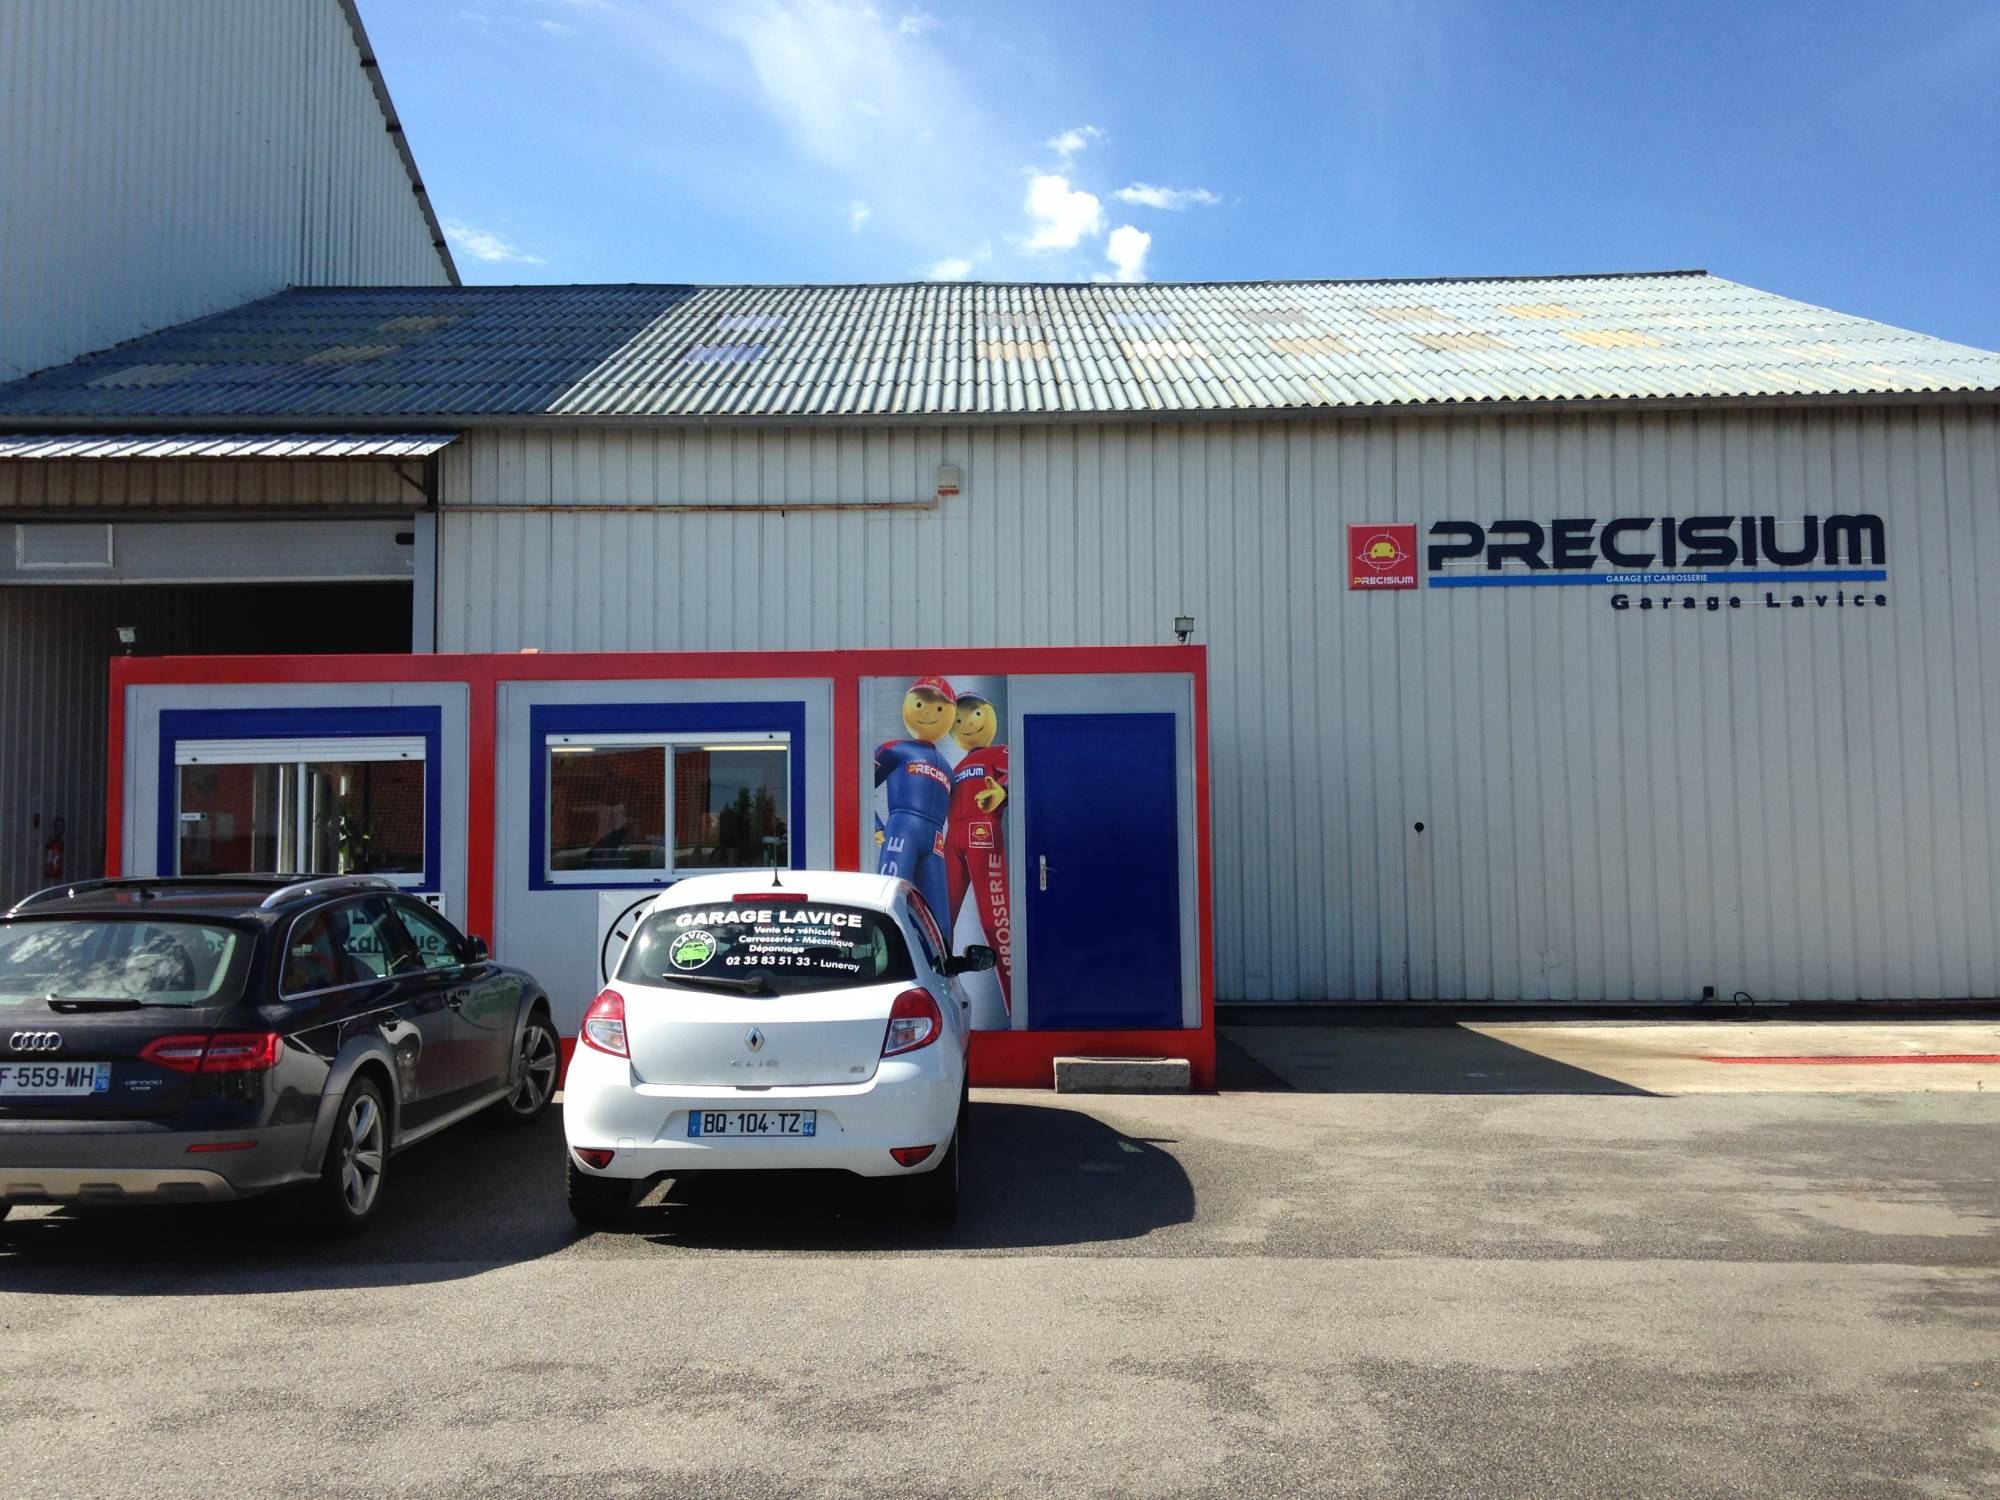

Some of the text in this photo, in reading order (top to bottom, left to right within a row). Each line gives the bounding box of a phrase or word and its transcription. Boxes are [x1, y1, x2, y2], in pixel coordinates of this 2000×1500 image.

[1428, 515, 1886, 570] PRECISIUM
[1353, 575, 1413, 585] PRECISIUM
[1606, 573, 1708, 583] GARAGE ET CARROSSERIE
[1610, 591, 1887, 611] Garage Lavice
[675, 910, 862, 928] GARAGE LAVICE
[753, 926, 841, 937] Vente de véhicules
[674, 931, 714, 948] LAVICE
[738, 935, 794, 944] Carrosserie
[802, 936, 854, 949] Mécanique
[749, 944, 805, 955] Dépannage
[725, 956, 741, 966] 02
[743, 956, 758, 965] 35
[760, 956, 776, 965] 83
[778, 956, 792, 966] 51
[796, 957, 811, 967] 33
[820, 959, 860, 973] Luneray
